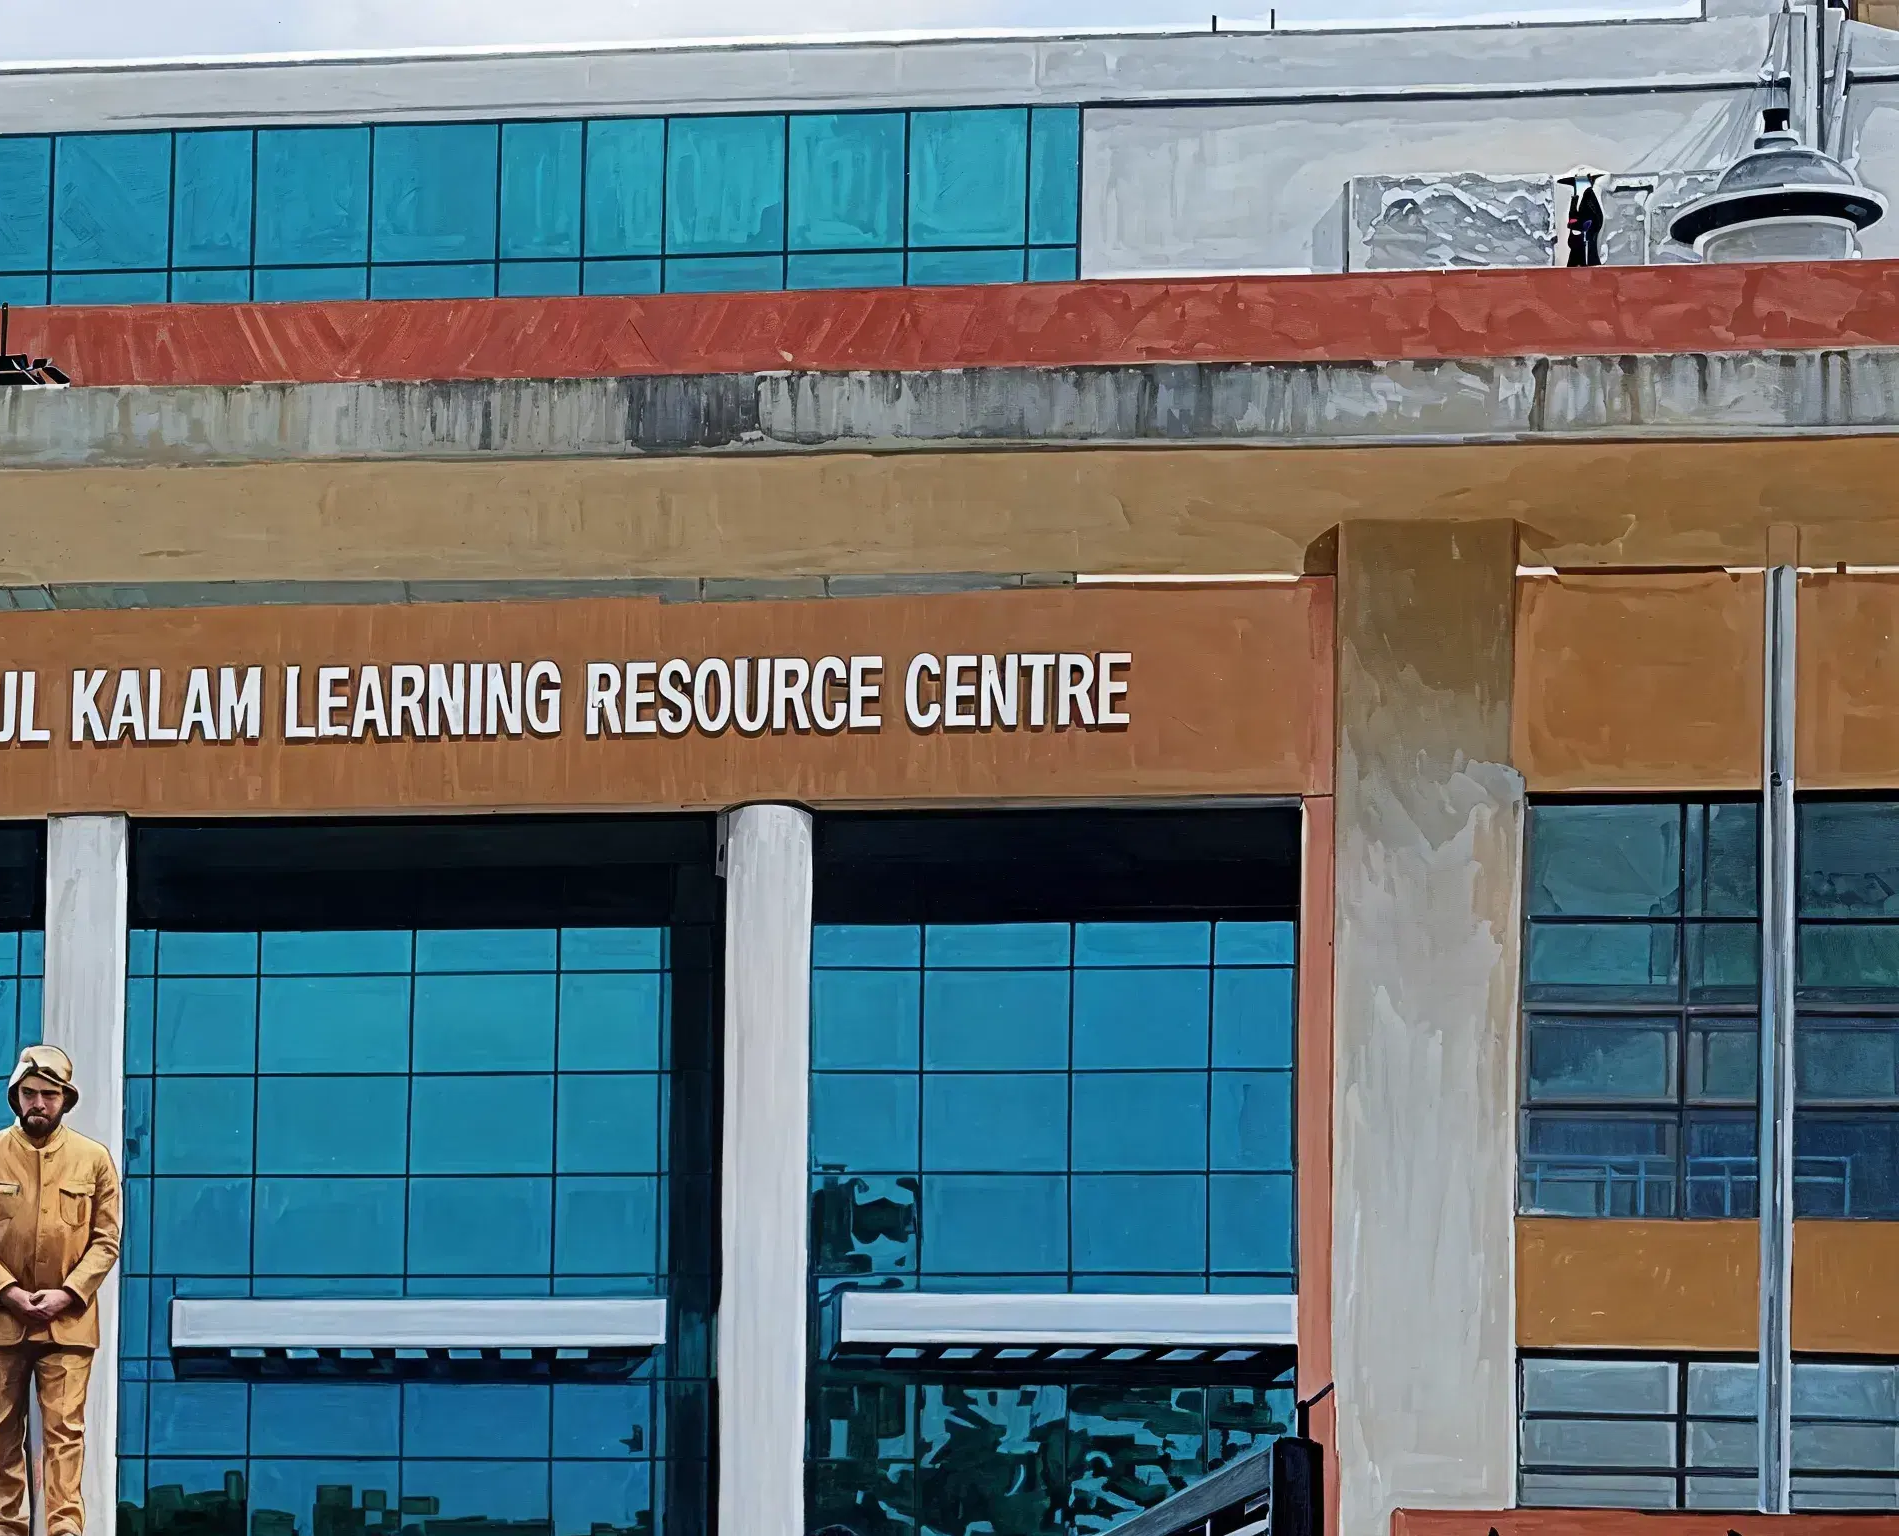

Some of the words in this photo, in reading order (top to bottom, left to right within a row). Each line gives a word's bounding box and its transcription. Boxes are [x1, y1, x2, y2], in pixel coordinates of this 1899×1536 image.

[71, 665, 263, 743] KALAM
[284, 659, 563, 740] LEARNING
[585, 655, 883, 736] RESOURCE
[904, 651, 1133, 729] CENTRE
